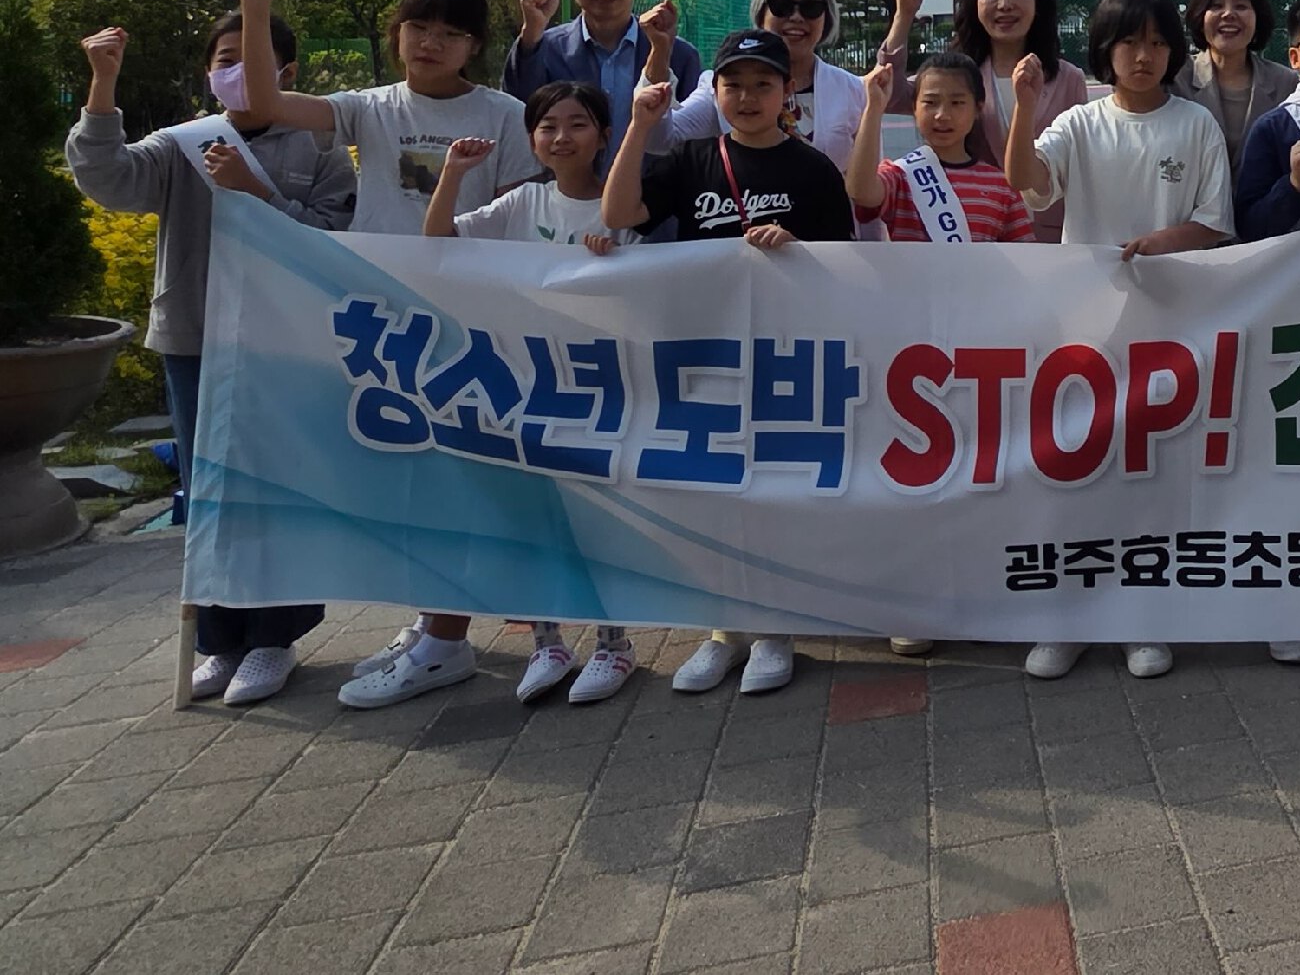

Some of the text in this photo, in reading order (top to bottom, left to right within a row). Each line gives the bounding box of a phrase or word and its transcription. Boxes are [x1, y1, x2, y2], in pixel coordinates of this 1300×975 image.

[399, 135, 417, 145] LOS
[913, 166, 947, 208] 여가
[334, 300, 625, 479] 청소년
[636, 338, 860, 489] 도박
[880, 331, 1239, 488] STOP!
